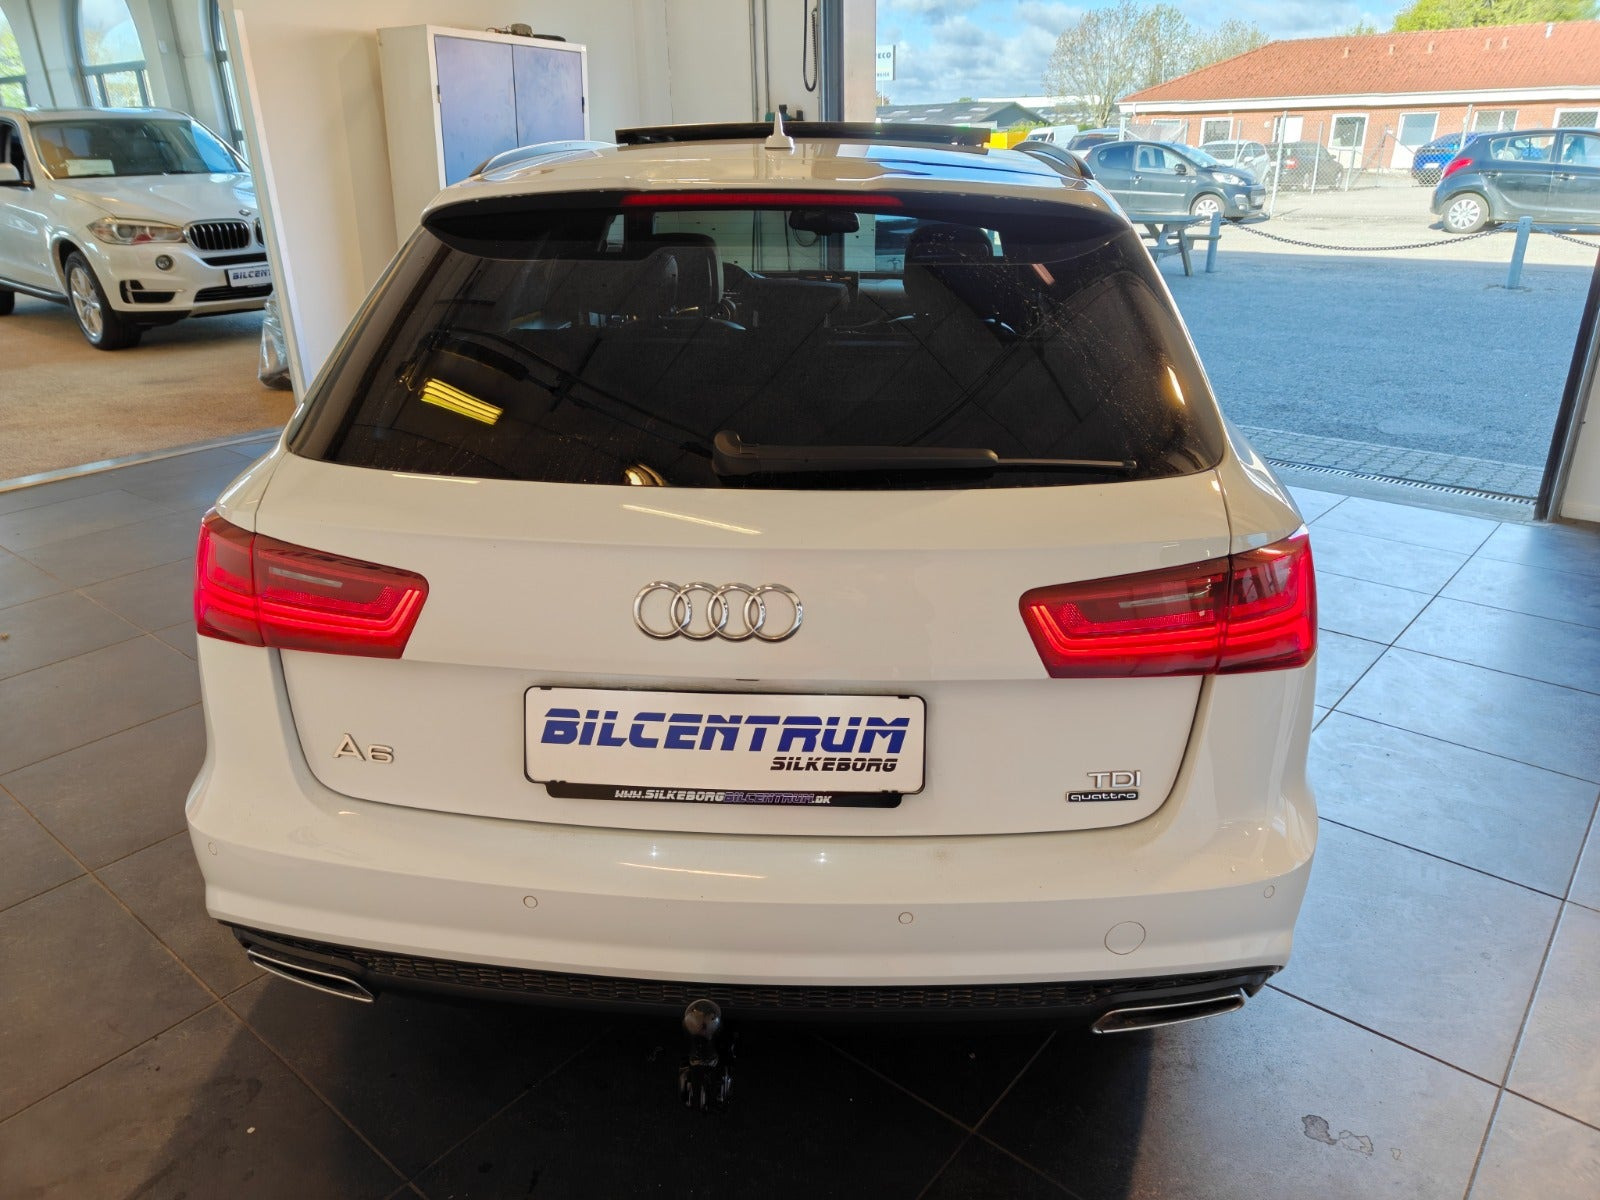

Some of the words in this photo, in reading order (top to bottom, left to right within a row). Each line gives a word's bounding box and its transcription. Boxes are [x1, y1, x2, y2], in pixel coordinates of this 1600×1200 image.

[540, 708, 910, 754] BILCENTRUM
[333, 732, 394, 764] A6
[770, 756, 899, 773] SILKEBORG
[1087, 769, 1141, 788] TDI
[1069, 791, 1138, 802] quattro
